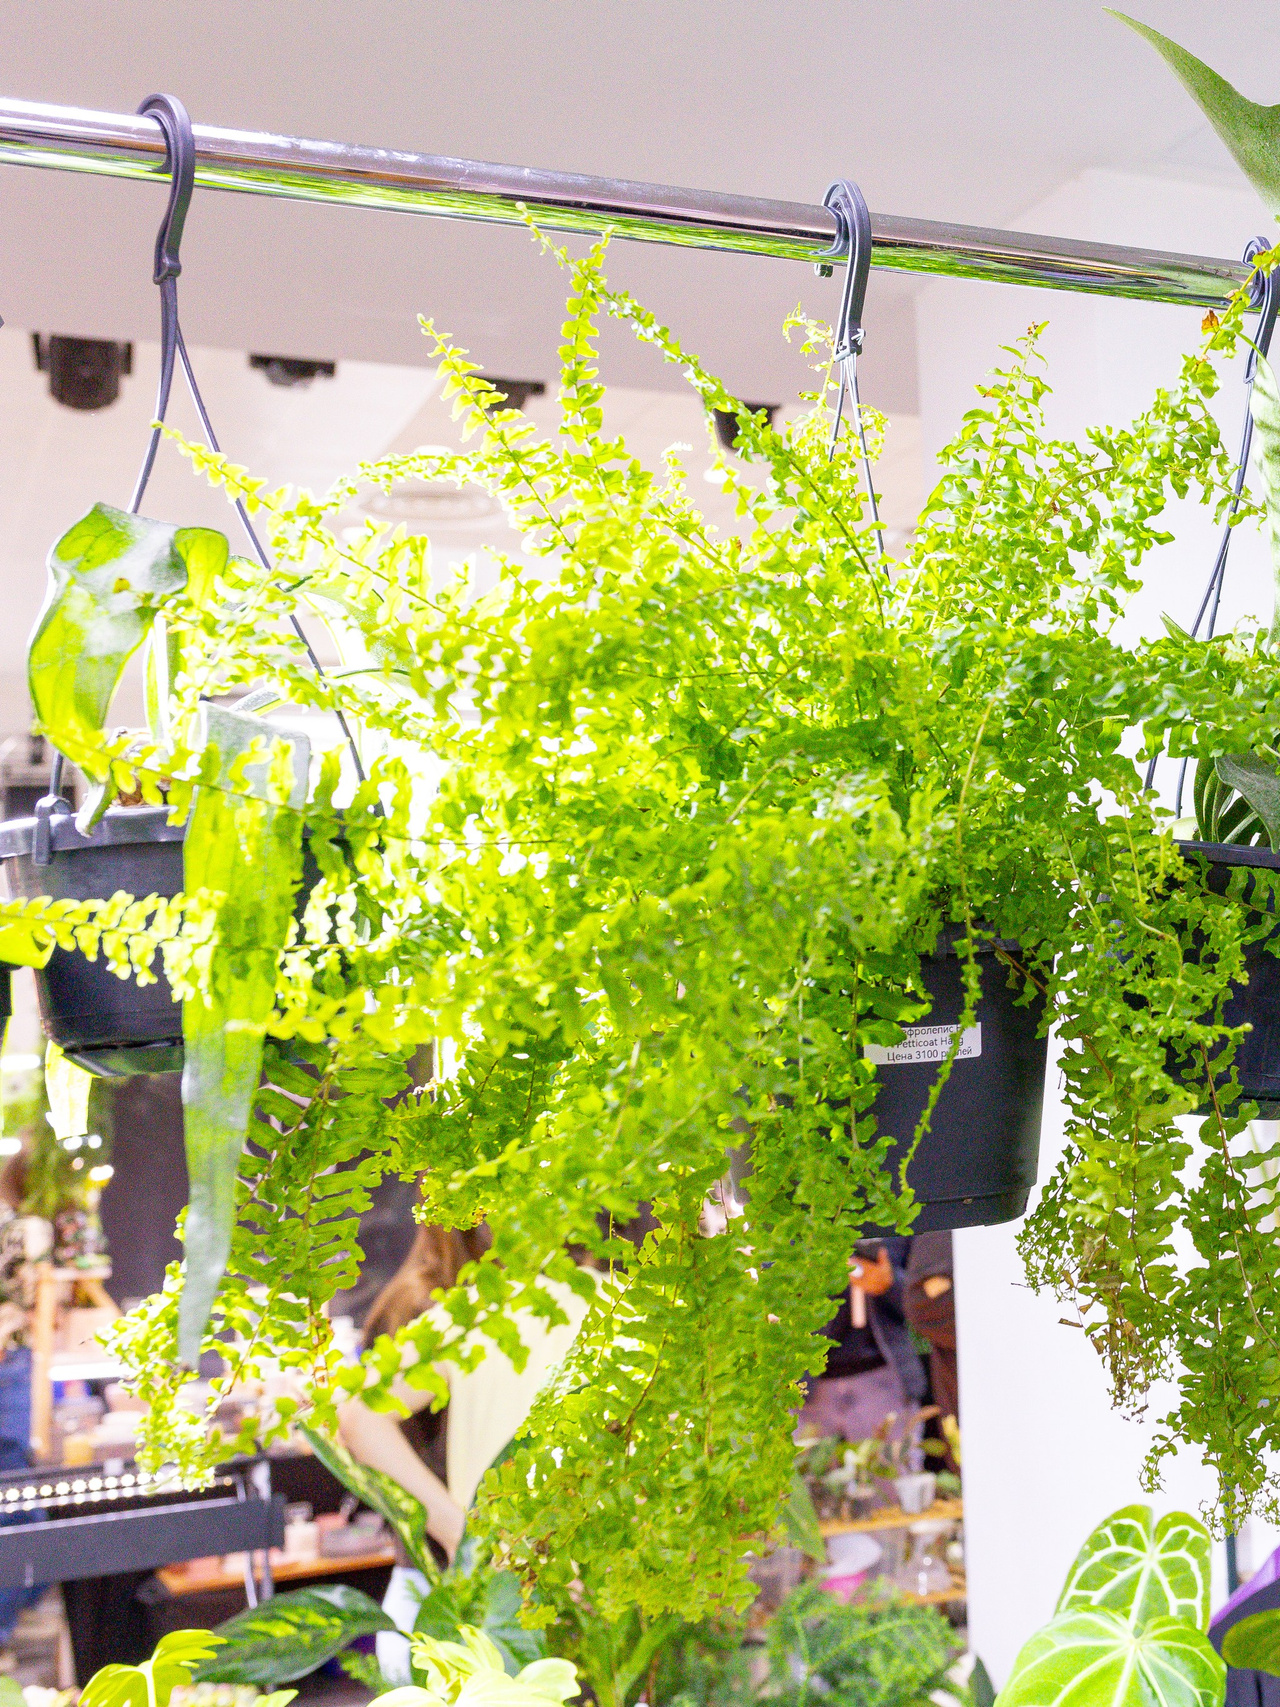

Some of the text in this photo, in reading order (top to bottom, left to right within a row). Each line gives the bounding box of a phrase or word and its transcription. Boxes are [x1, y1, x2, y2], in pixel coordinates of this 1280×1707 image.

[940, 1036, 964, 1047] Hag
[887, 1051, 913, 1062] Цена
[915, 1049, 938, 1060] 3100
